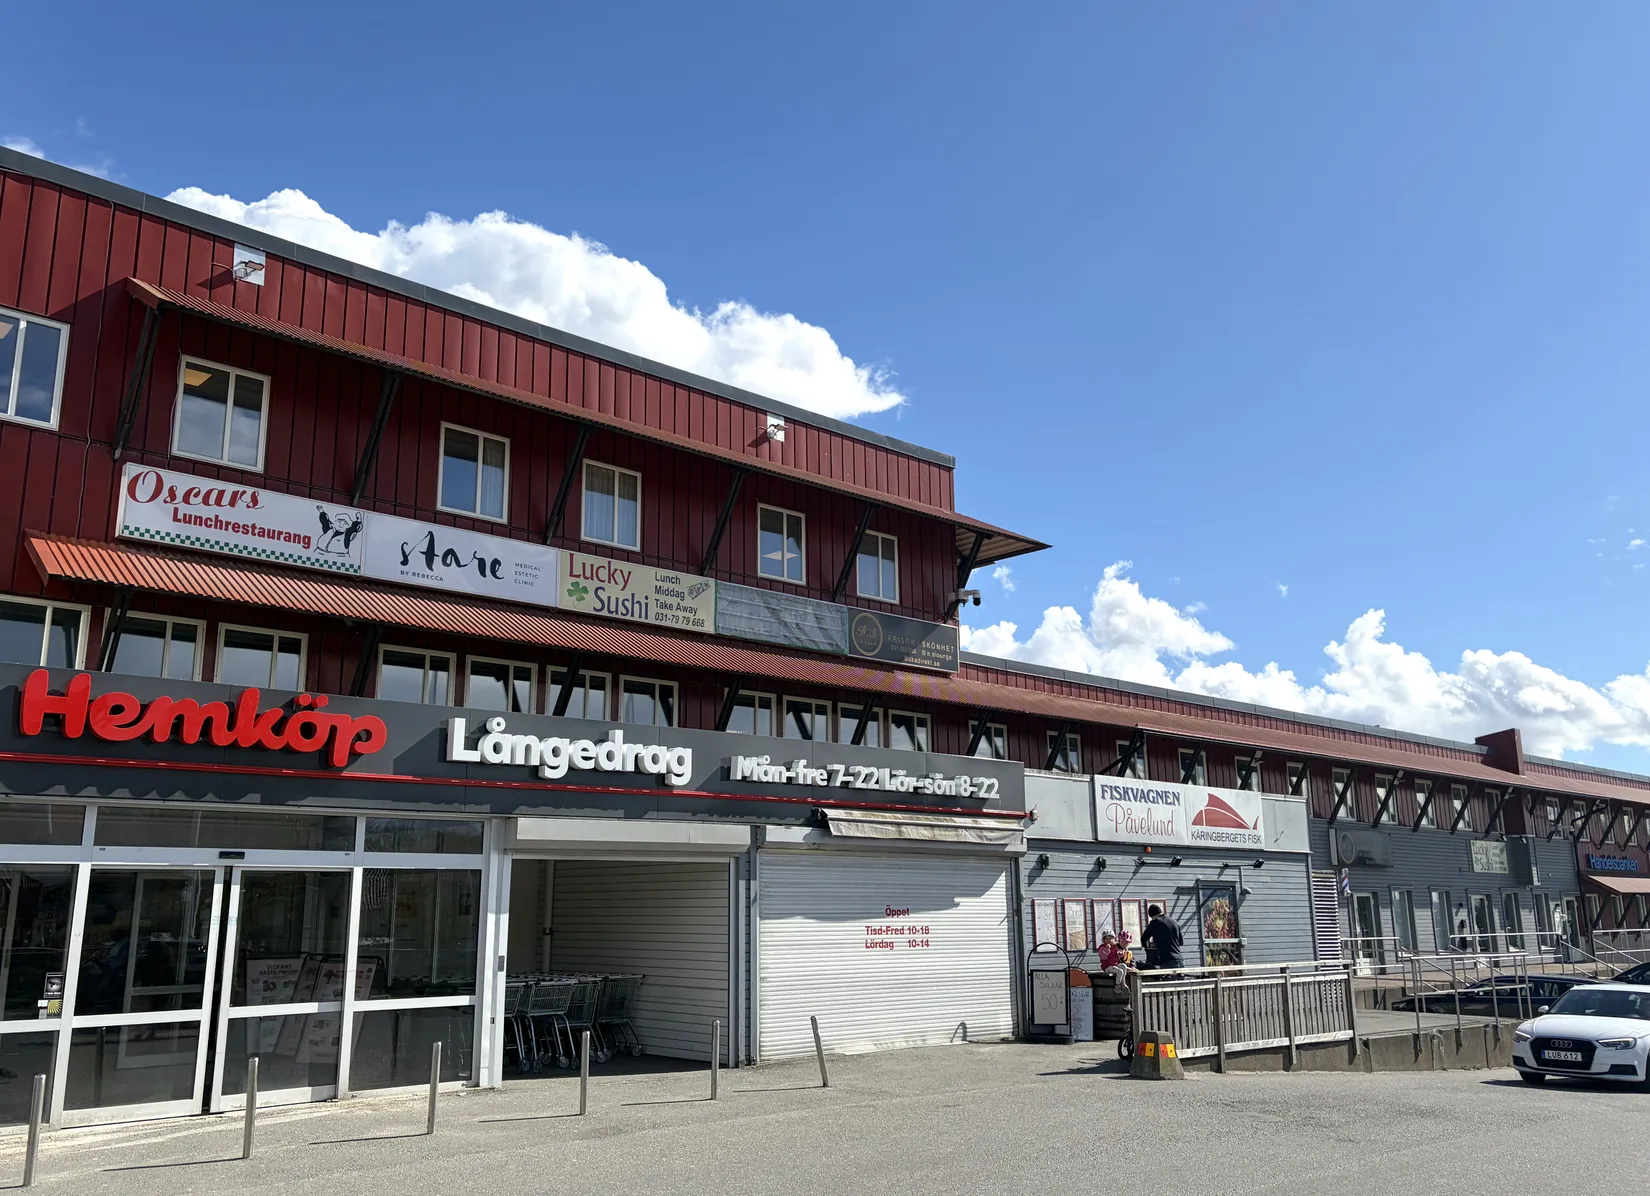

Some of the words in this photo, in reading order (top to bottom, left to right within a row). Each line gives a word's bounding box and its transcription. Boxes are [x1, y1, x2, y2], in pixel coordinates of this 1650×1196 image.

[127, 470, 264, 510] Oscars
[172, 507, 312, 550] Lunchrestaurang
[514, 562, 541, 571] MEDICAL
[569, 553, 632, 591] Lucky
[412, 571, 444, 582] REBECCA
[514, 571, 538, 579] ESTETIC
[655, 571, 681, 585] Lunch
[514, 579, 534, 587] CLINIC
[654, 585, 685, 601] Middag
[593, 586, 649, 620] Sushi
[654, 598, 674, 610] Take
[676, 602, 698, 616] Away
[654, 612, 680, 624] 031-79
[681, 615, 691, 625] 79
[921, 640, 955, 653] SKÖNHET
[20, 668, 388, 768] Hemköp
[446, 716, 692, 786] Långedrag
[730, 754, 828, 787] Mån-fre
[827, 763, 880, 790] 7-22
[878, 768, 957, 796] Lör-sön
[953, 775, 1000, 799] 8-22
[1100, 783, 1181, 806] FISKVAGNEN
[1105, 802, 1176, 837] Påvelund
[1247, 834, 1262, 844] FISK
[885, 904, 910, 918] Öppet
[865, 926, 905, 935] Tisd-Fred
[907, 926, 930, 935] 10-18
[865, 939, 894, 950] Lördag
[907, 939, 930, 948] 10-14
[1564, 1052, 1579, 1060] 612
